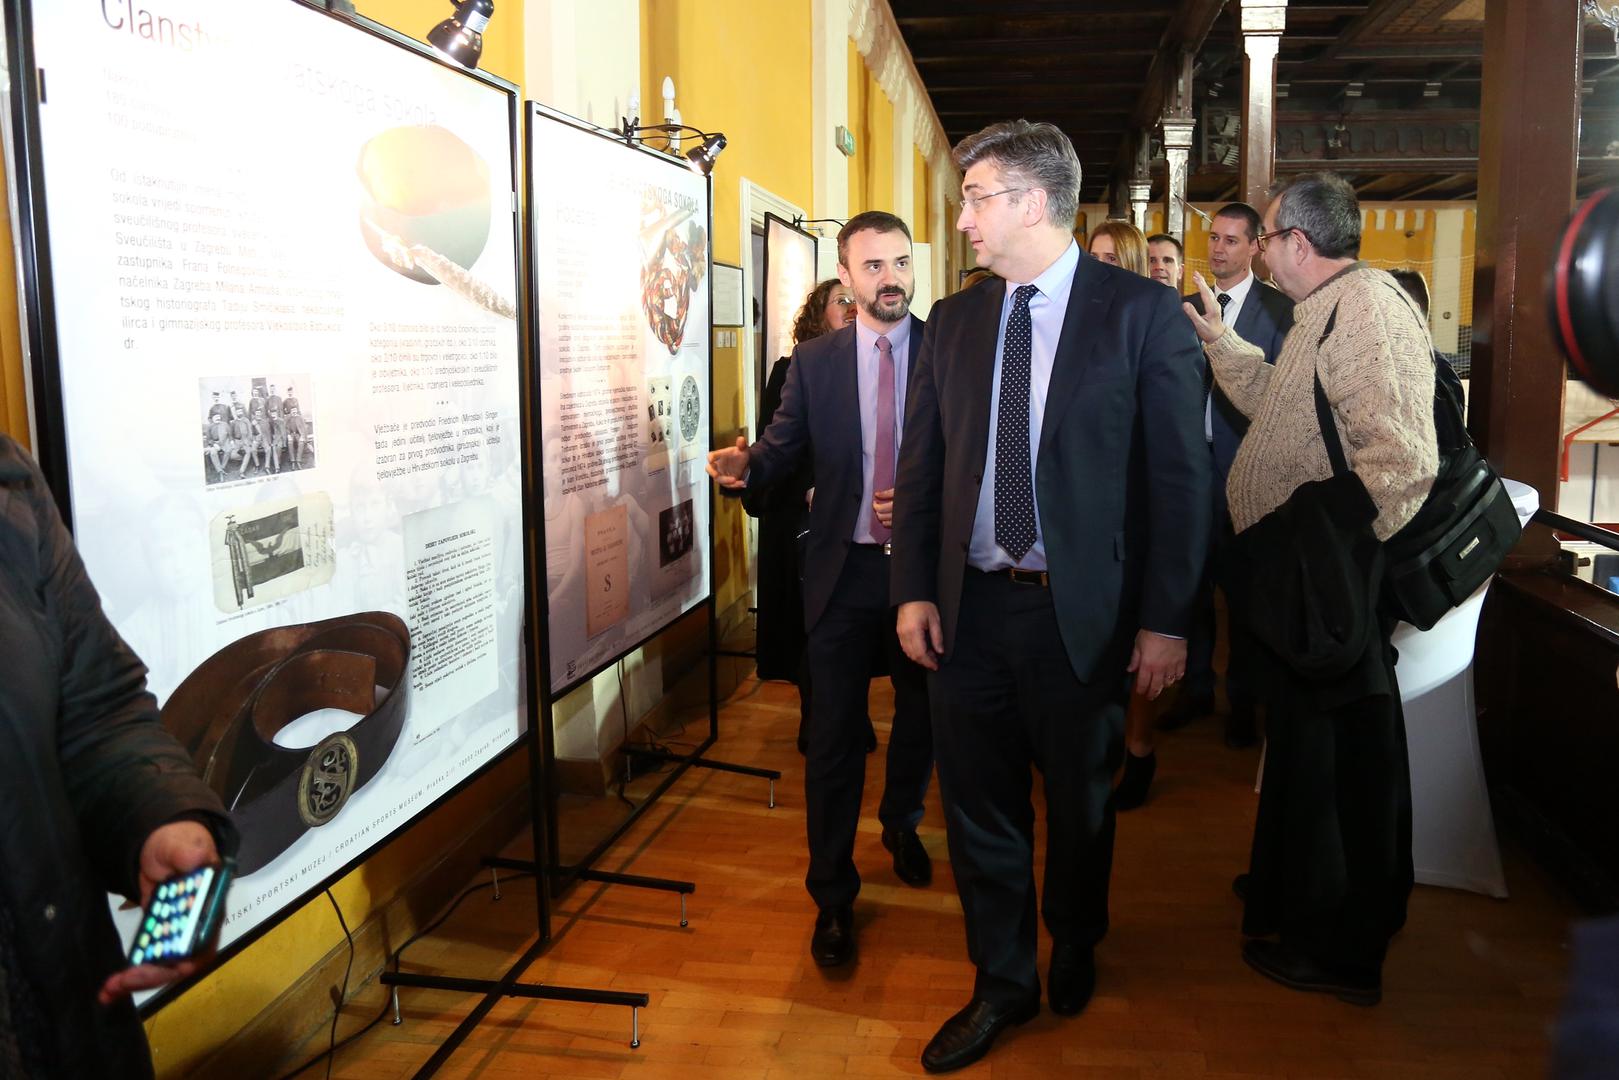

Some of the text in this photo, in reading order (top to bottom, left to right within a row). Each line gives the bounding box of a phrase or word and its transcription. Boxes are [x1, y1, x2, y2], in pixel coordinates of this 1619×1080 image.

[112, 192, 148, 207] sokola
[151, 197, 181, 213] vrijedi
[674, 191, 699, 214] SOKOLA
[114, 213, 179, 233] sveučilišnog
[115, 232, 172, 250] Sveučilišta
[181, 242, 186, 251] u
[195, 241, 231, 257] Zagrebu
[118, 255, 173, 271] zastupnika
[183, 259, 208, 272] Frana
[119, 275, 168, 290] načelnika
[173, 278, 211, 293] Zagreba
[216, 281, 245, 293] Milana
[120, 296, 150, 311] tskog
[156, 298, 216, 312] historiografa
[122, 315, 147, 329] ilirca
[159, 317, 221, 332] gimnazijskog
[224, 319, 265, 332] profesora
[375, 440, 388, 449] tada
[376, 454, 397, 465] izabran
[408, 449, 423, 460] prvog
[412, 460, 439, 472] Hrvatskom
[440, 457, 456, 468] sokolu
[225, 904, 253, 926] ATSKI
[301, 855, 326, 876] MUZEJ
[335, 826, 370, 853] CROATIAN
[372, 808, 397, 829] SPORTS
